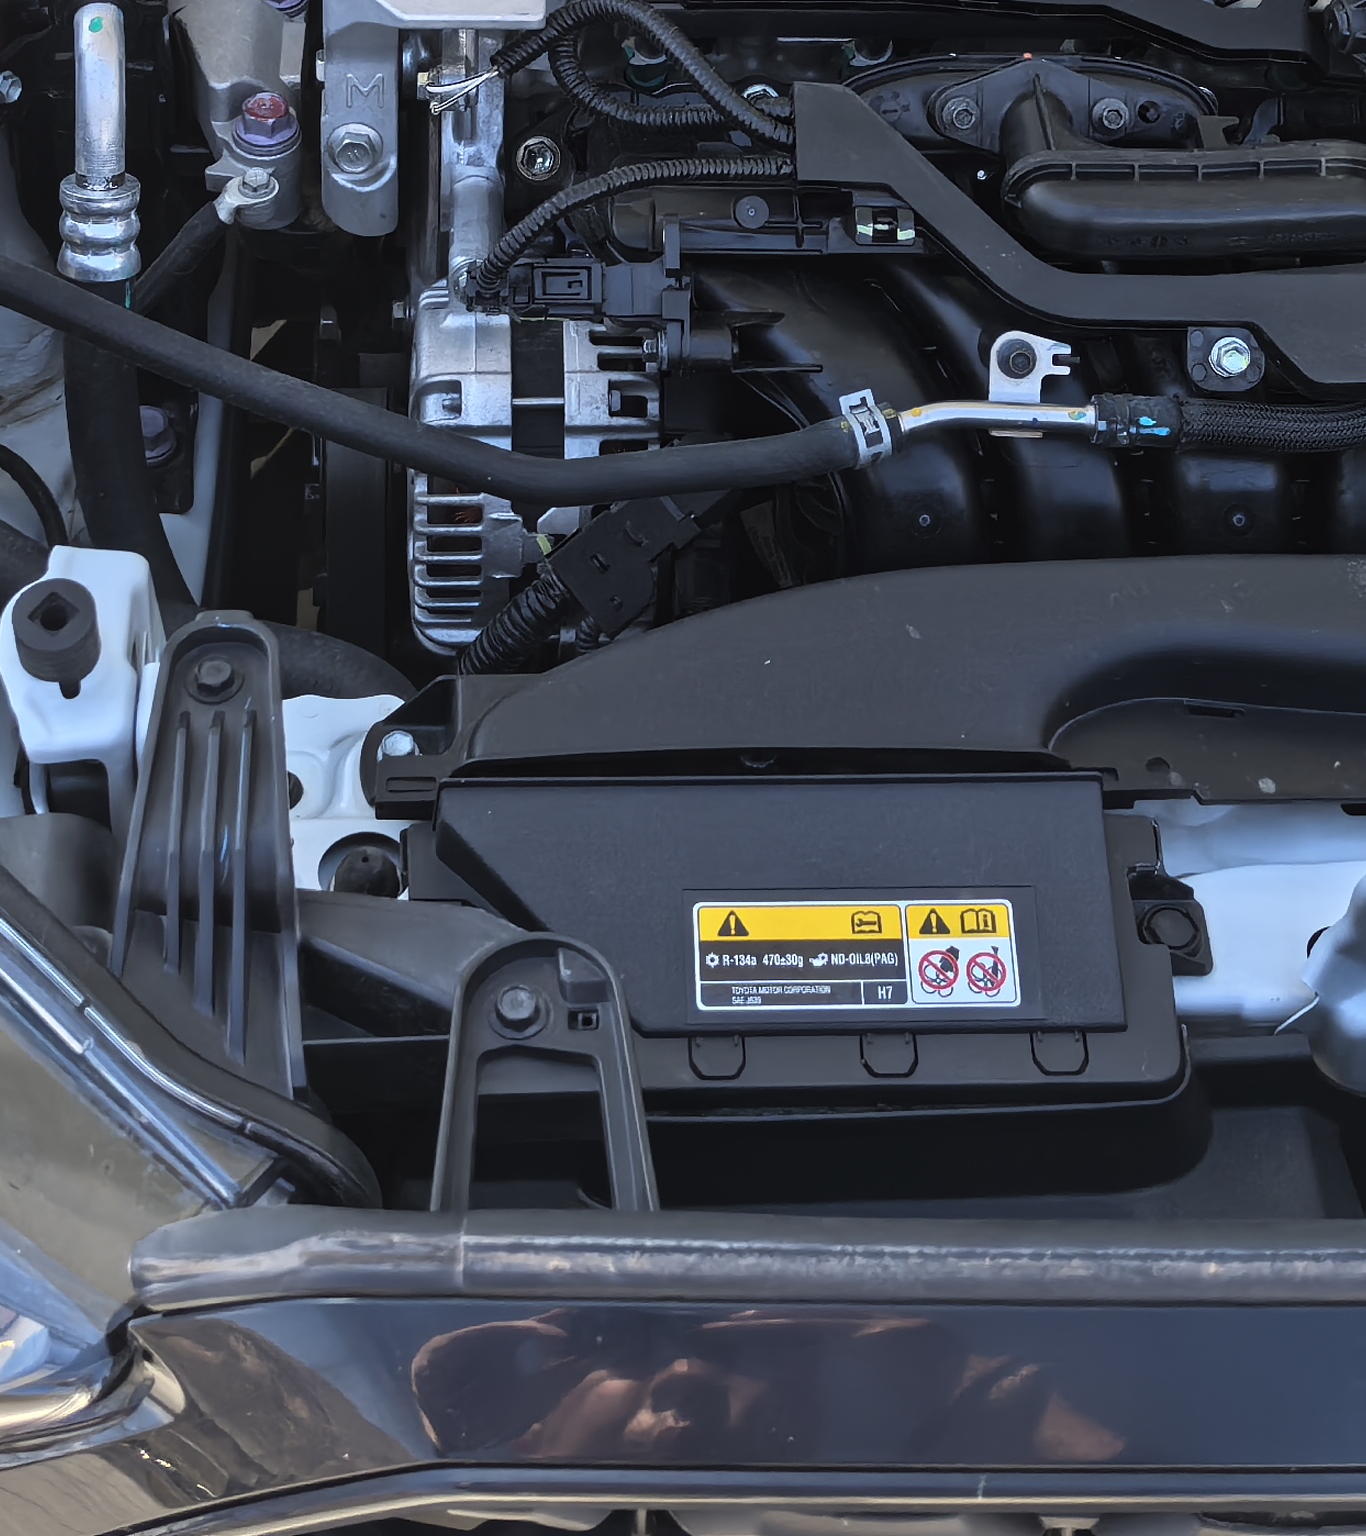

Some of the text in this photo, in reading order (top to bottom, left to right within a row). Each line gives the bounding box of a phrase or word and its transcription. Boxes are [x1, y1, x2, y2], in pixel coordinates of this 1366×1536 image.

[346, 73, 384, 109] M
[723, 953, 898, 967] R-134a 470±30g ND-OIL8(PAG)
[732, 985, 893, 1000] TOYOTA MOTOR CORPORATION H7
